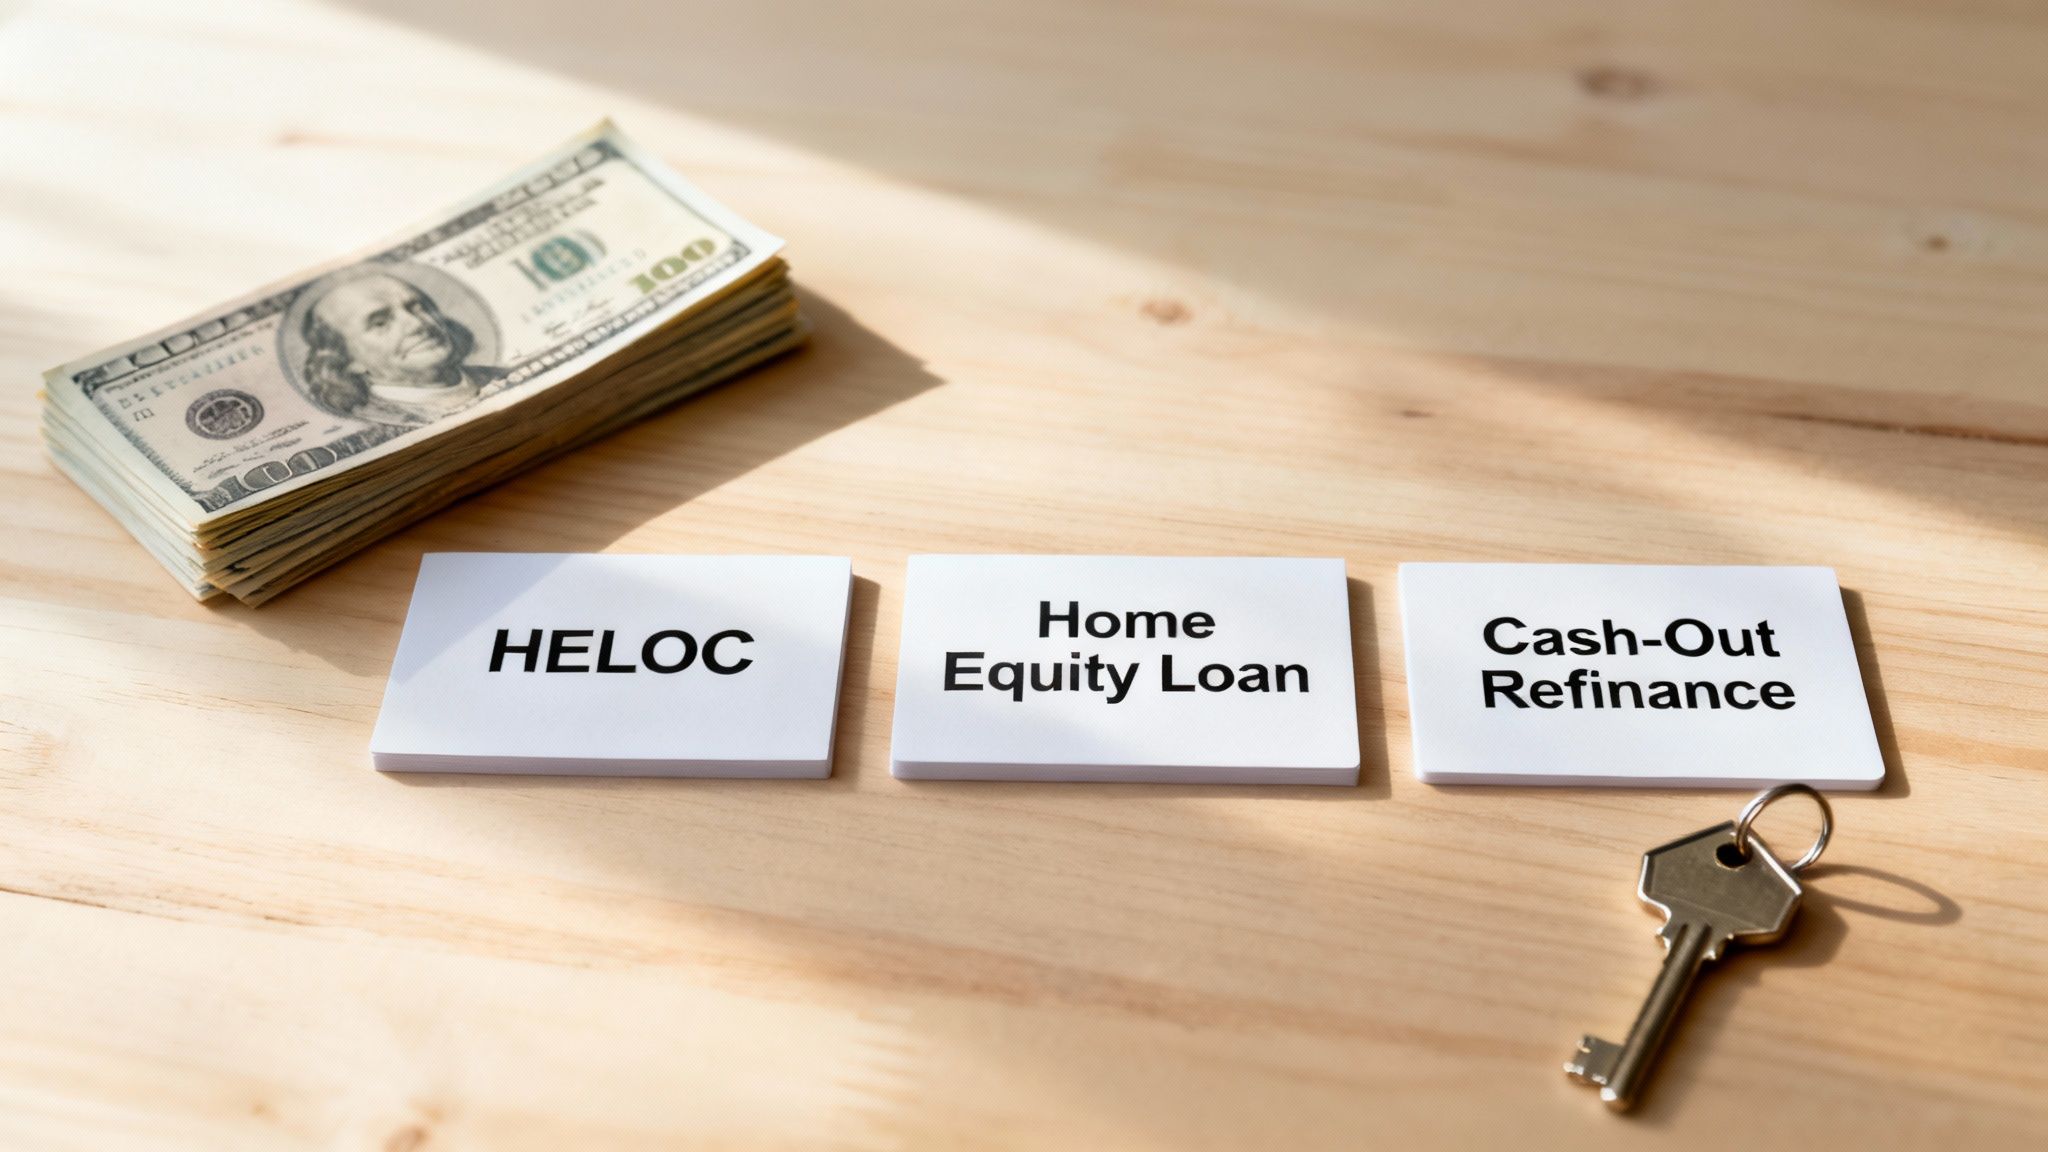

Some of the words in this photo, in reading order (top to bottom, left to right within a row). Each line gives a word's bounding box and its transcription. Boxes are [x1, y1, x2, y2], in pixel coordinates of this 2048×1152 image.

[630, 238, 716, 295] 100
[217, 446, 337, 496] 100
[1039, 600, 1216, 639] Home
[1483, 616, 1781, 658] Cash-Out
[488, 628, 755, 676] HELOC
[943, 651, 1140, 705] Equity
[1161, 654, 1309, 693] Loan
[1481, 668, 1796, 710] Refinance
